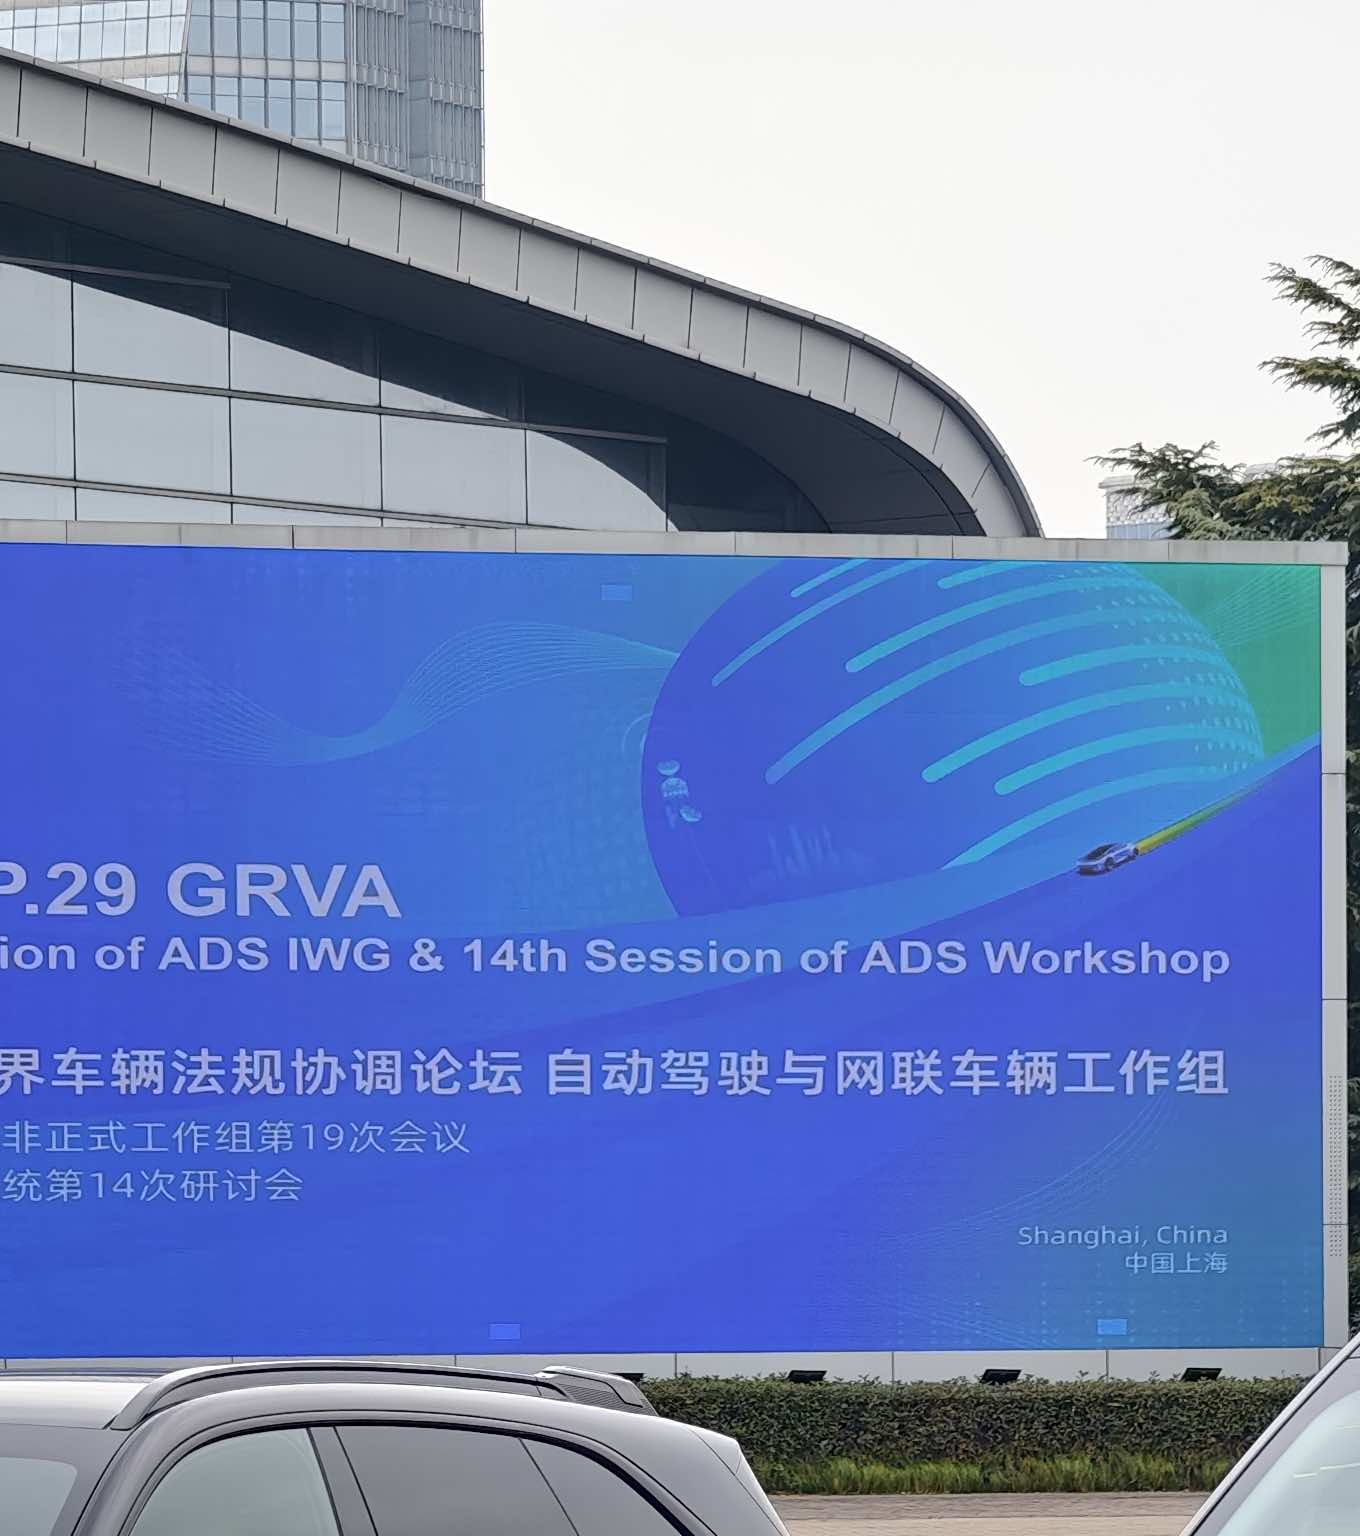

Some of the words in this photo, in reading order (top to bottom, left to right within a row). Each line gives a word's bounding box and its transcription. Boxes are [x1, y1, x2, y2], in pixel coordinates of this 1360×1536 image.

[167, 862, 403, 919] GRVA
[95, 936, 147, 971] of
[159, 937, 271, 972] ADS
[288, 938, 391, 973] IWG
[409, 939, 446, 973] &
[464, 939, 568, 973] 14th
[586, 939, 783, 974] Session
[801, 941, 850, 975] of
[861, 941, 968, 975] ADS
[983, 941, 1231, 984] Workshop
[548, 1048, 1231, 1098] 自动驾驶与网联车辆工作组
[1017, 1225, 1149, 1250] Shanghai,
[1156, 1225, 1229, 1246] China
[1125, 1252, 1229, 1275] 中国上海
